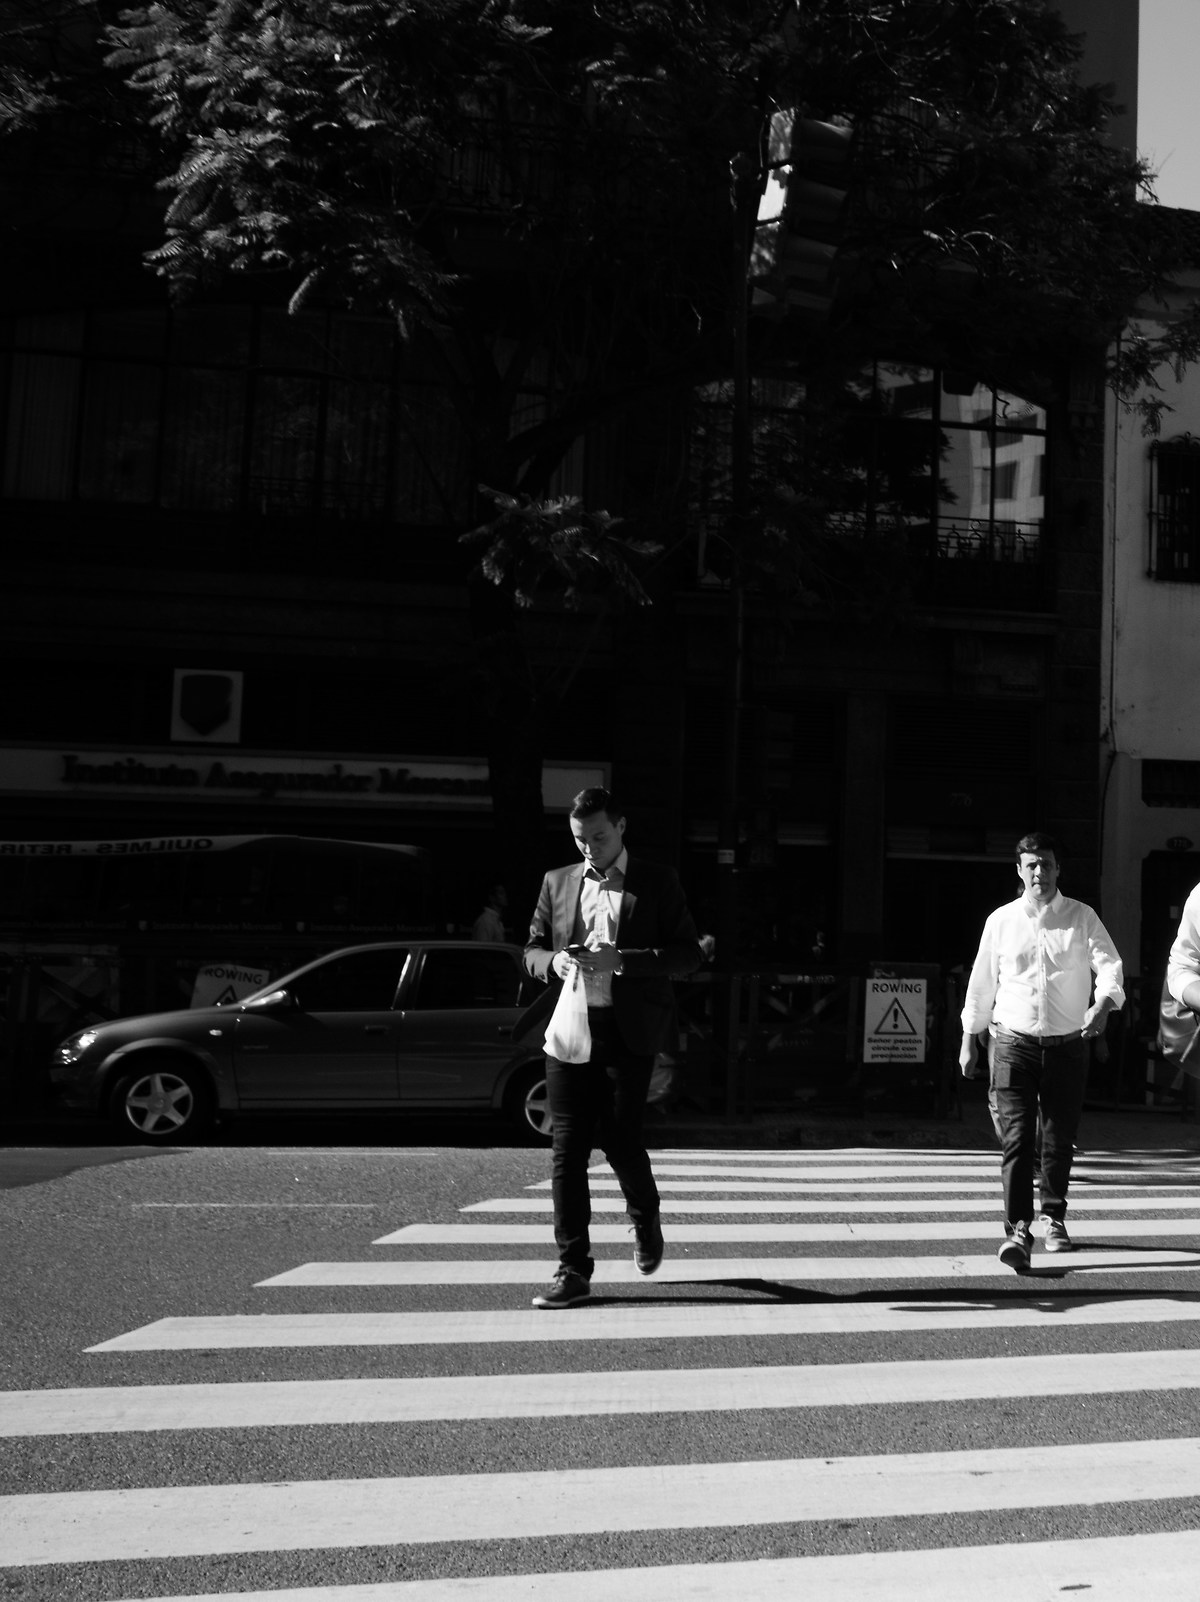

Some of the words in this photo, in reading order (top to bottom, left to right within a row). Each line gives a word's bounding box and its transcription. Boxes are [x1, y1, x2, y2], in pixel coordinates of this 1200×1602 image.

[62, 755, 199, 785] Instituto
[204, 763, 373, 798] Asegurador
[377, 769, 490, 796] Mercan
[872, 983, 922, 993] ROWING
